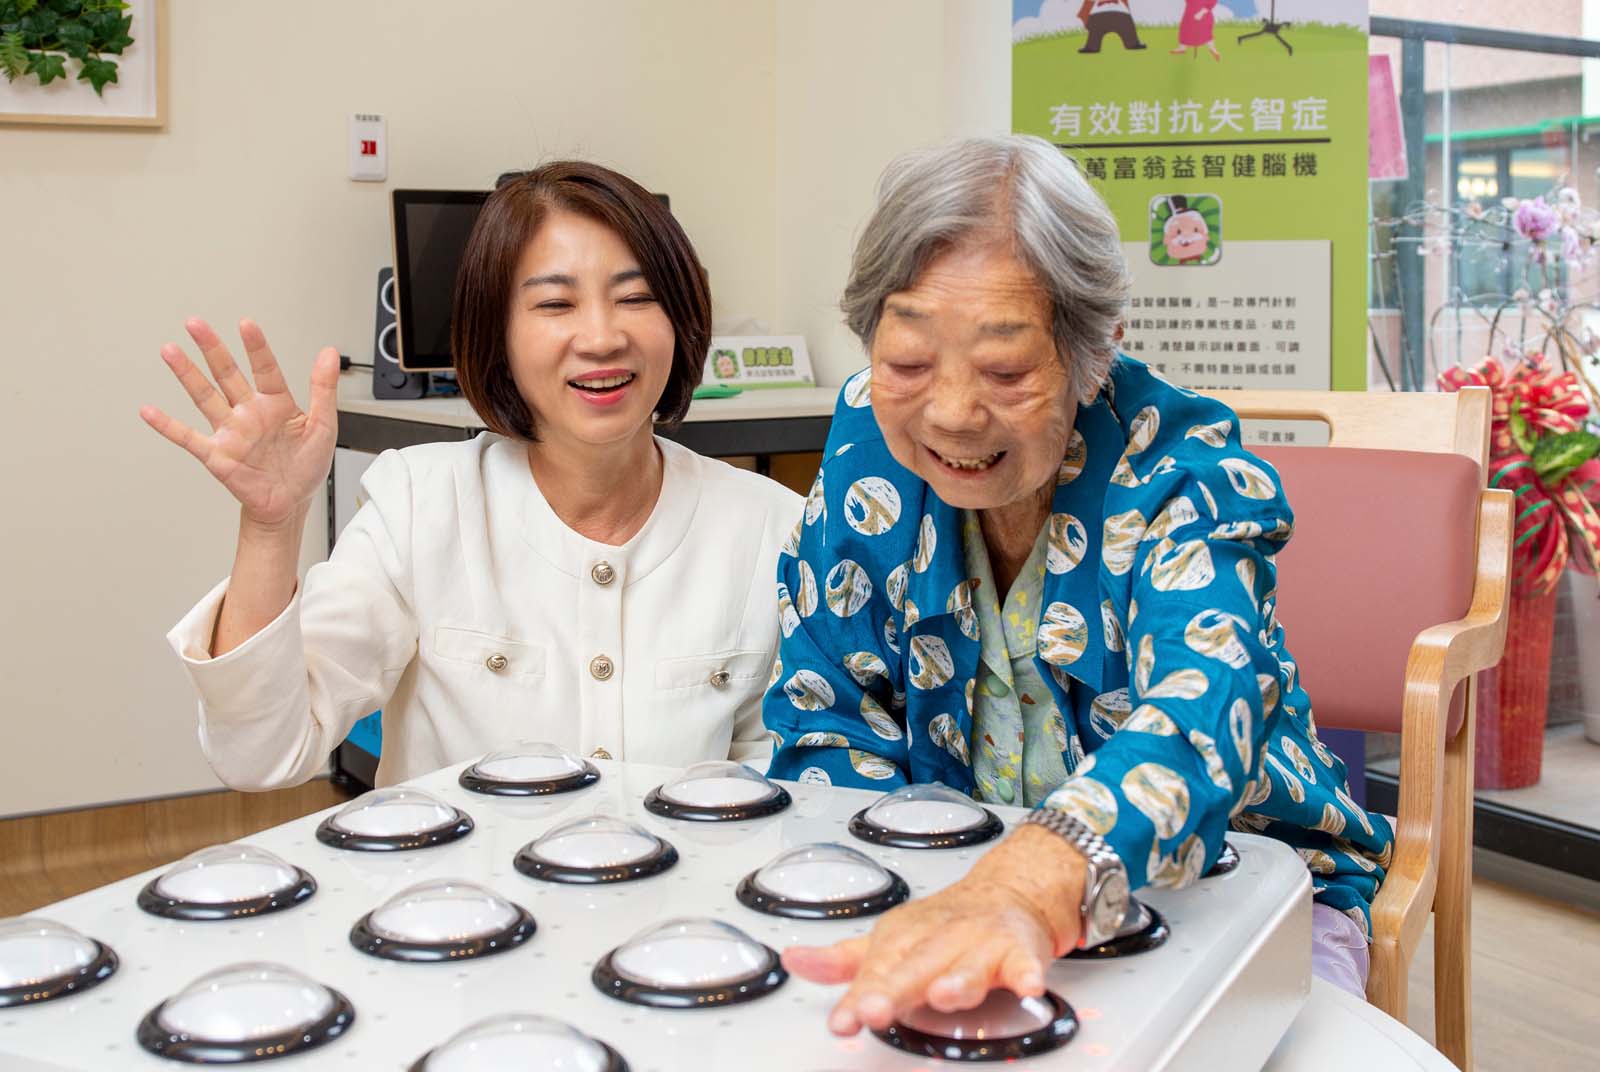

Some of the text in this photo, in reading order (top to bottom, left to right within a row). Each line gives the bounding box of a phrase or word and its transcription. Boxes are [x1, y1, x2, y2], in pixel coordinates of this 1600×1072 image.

[1049, 96, 1329, 137] 有效對抗失智症
[1070, 152, 1317, 181] 萬富翁益智健腦機
[1149, 362, 1296, 375] 度，不需特意抬頭或低頭
